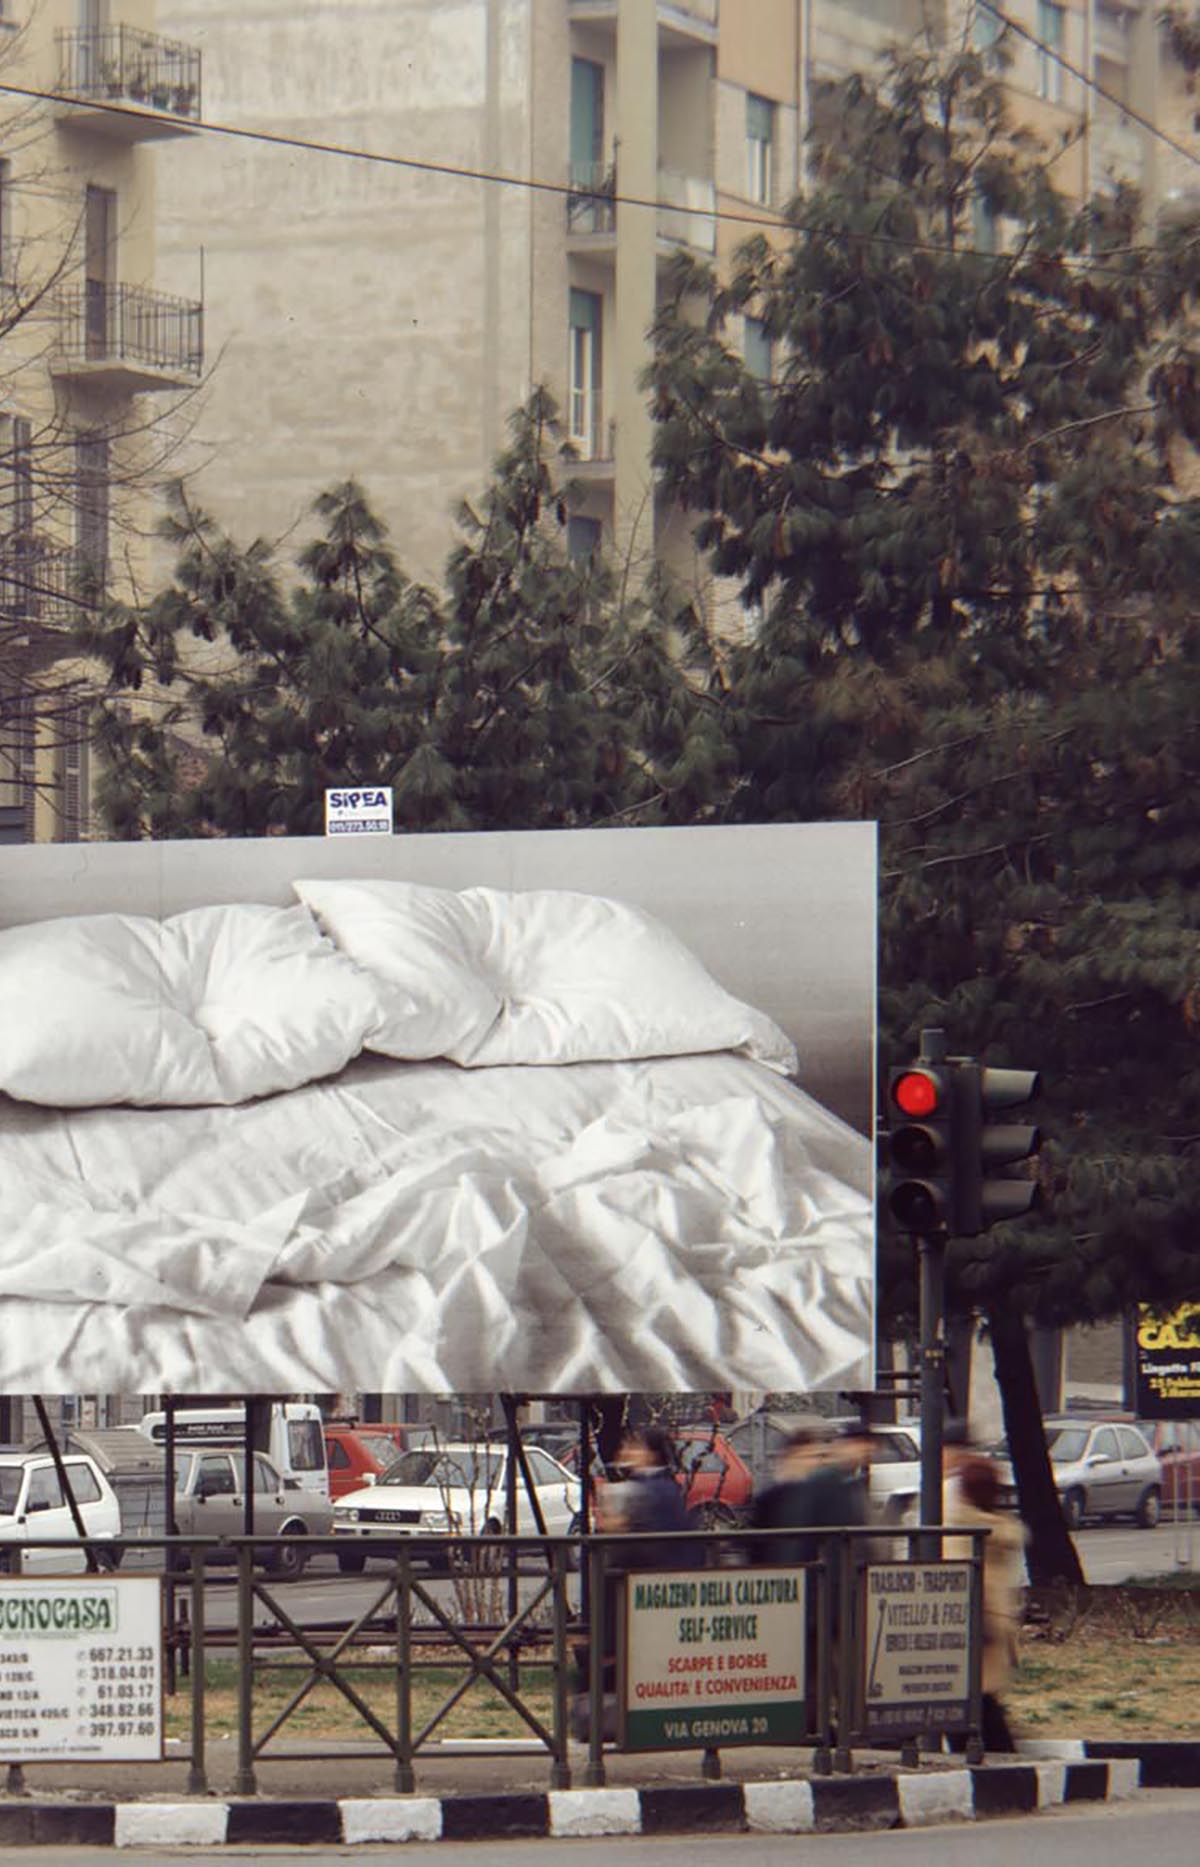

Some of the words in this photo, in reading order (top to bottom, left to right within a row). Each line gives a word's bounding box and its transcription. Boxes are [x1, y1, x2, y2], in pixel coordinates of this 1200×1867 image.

[701, 1580, 732, 1608] DELLA
[735, 1578, 799, 1606] CALZATURA
[679, 1614, 758, 1643] SELF-SERVICE
[668, 1656, 714, 1673] SCARPE
[717, 1655, 724, 1670] E
[728, 1653, 768, 1670] BORSE
[695, 1680, 702, 1695] E
[706, 1675, 798, 1696] CONVENIENZA
[664, 1720, 689, 1739] VIA
[692, 1718, 749, 1737] GENOVA
